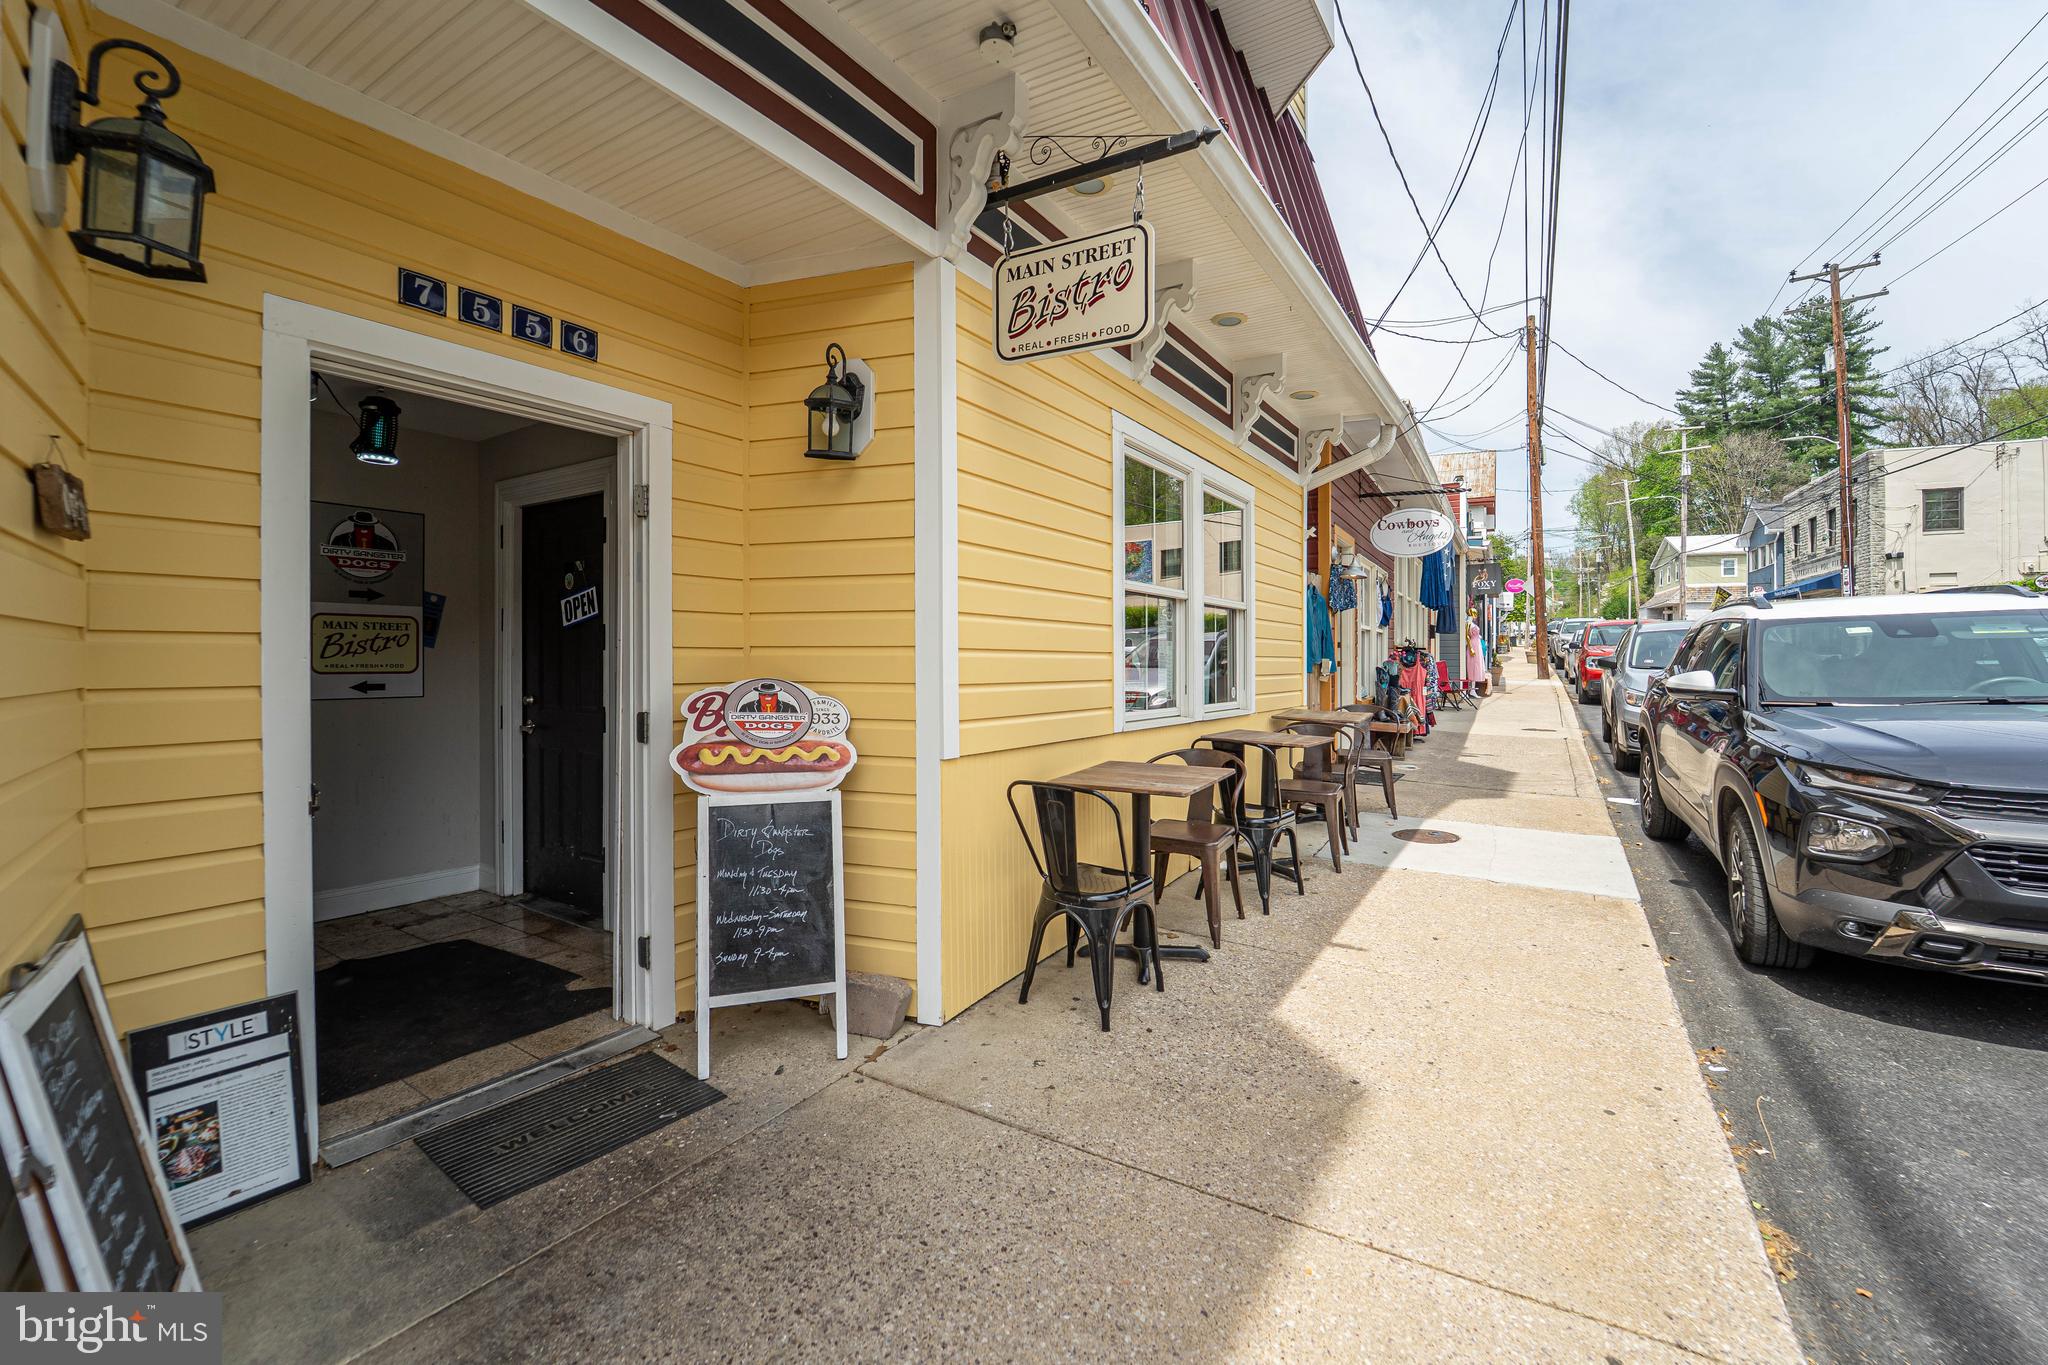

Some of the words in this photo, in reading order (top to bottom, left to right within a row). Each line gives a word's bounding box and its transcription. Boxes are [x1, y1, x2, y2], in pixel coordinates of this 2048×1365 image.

[1006, 257, 1056, 283] MAIN
[1061, 236, 1137, 270] STREET
[1007, 258, 1135, 340] Bistro
[414, 277, 588, 353] 7556
[1018, 340, 1044, 352] REAL
[1054, 331, 1089, 346] FRESH
[1099, 323, 1130, 337] FOOD
[1377, 517, 1440, 534] Cowboys
[322, 547, 352, 556] DIRTY
[353, 549, 405, 561] GANGSTER
[337, 558, 391, 569] DOGS
[564, 589, 596, 623] OPEN
[322, 620, 359, 630] MAIN
[362, 621, 411, 632] STREET
[320, 632, 410, 660] Bistro
[813, 700, 838, 708] FAMILY
[744, 722, 795, 730] DOGS
[810, 726, 841, 736] FAVORITE
[188, 1018, 255, 1050] STYLE
[498, 1083, 655, 1154] WELCOME
